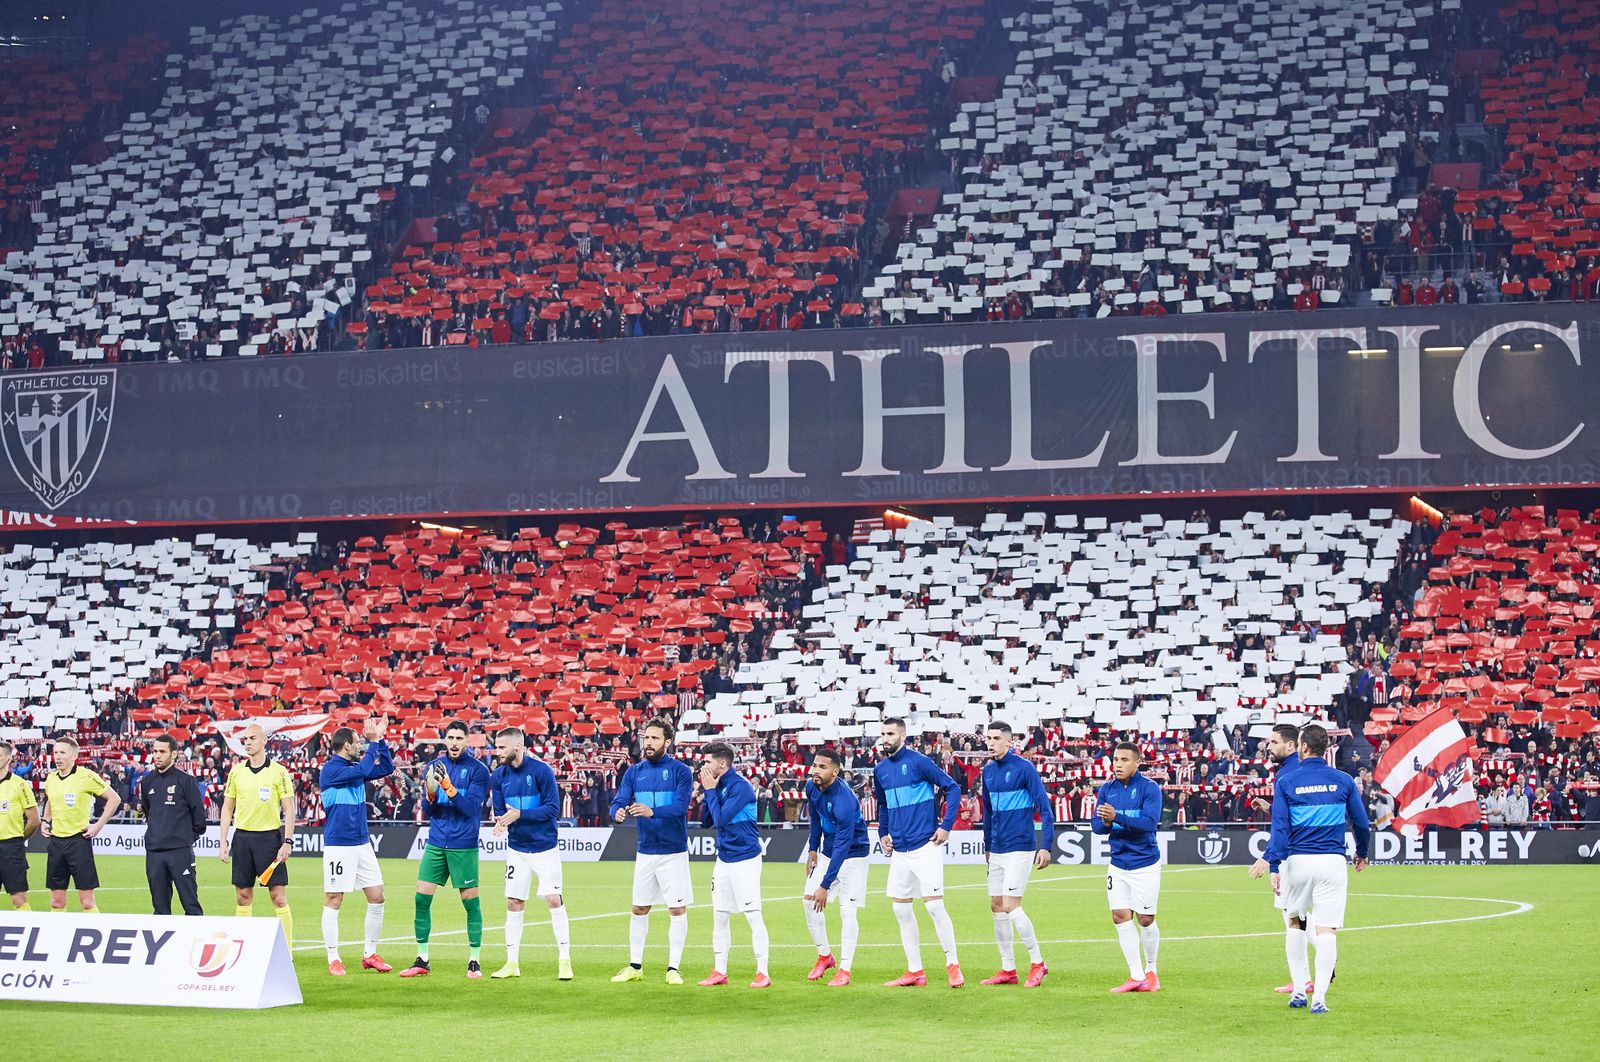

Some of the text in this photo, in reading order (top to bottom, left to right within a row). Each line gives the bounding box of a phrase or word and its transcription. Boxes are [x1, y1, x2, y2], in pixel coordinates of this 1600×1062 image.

[242, 363, 306, 390] IMQ
[336, 360, 440, 388] euskaltel
[513, 352, 621, 380] euskaltel
[7, 376, 69, 391] ATHLETIC
[72, 375, 108, 386] CLUB
[157, 367, 220, 394] IMQ
[599, 320, 1586, 483] ATHLETIC
[238, 493, 303, 519] IMQ
[1295, 784, 1338, 794] GRANADA CF
[116, 835, 144, 850] Agui
[478, 839, 602, 853] Agui Bilbao
[961, 842, 986, 855] Bil
[1057, 831, 1176, 864] SET
[1375, 831, 1447, 860] DEL
[1461, 830, 1537, 859] REY
[329, 861, 343, 876] 16
[66, 928, 176, 966] REY
[1, 970, 54, 989] CIÓN
